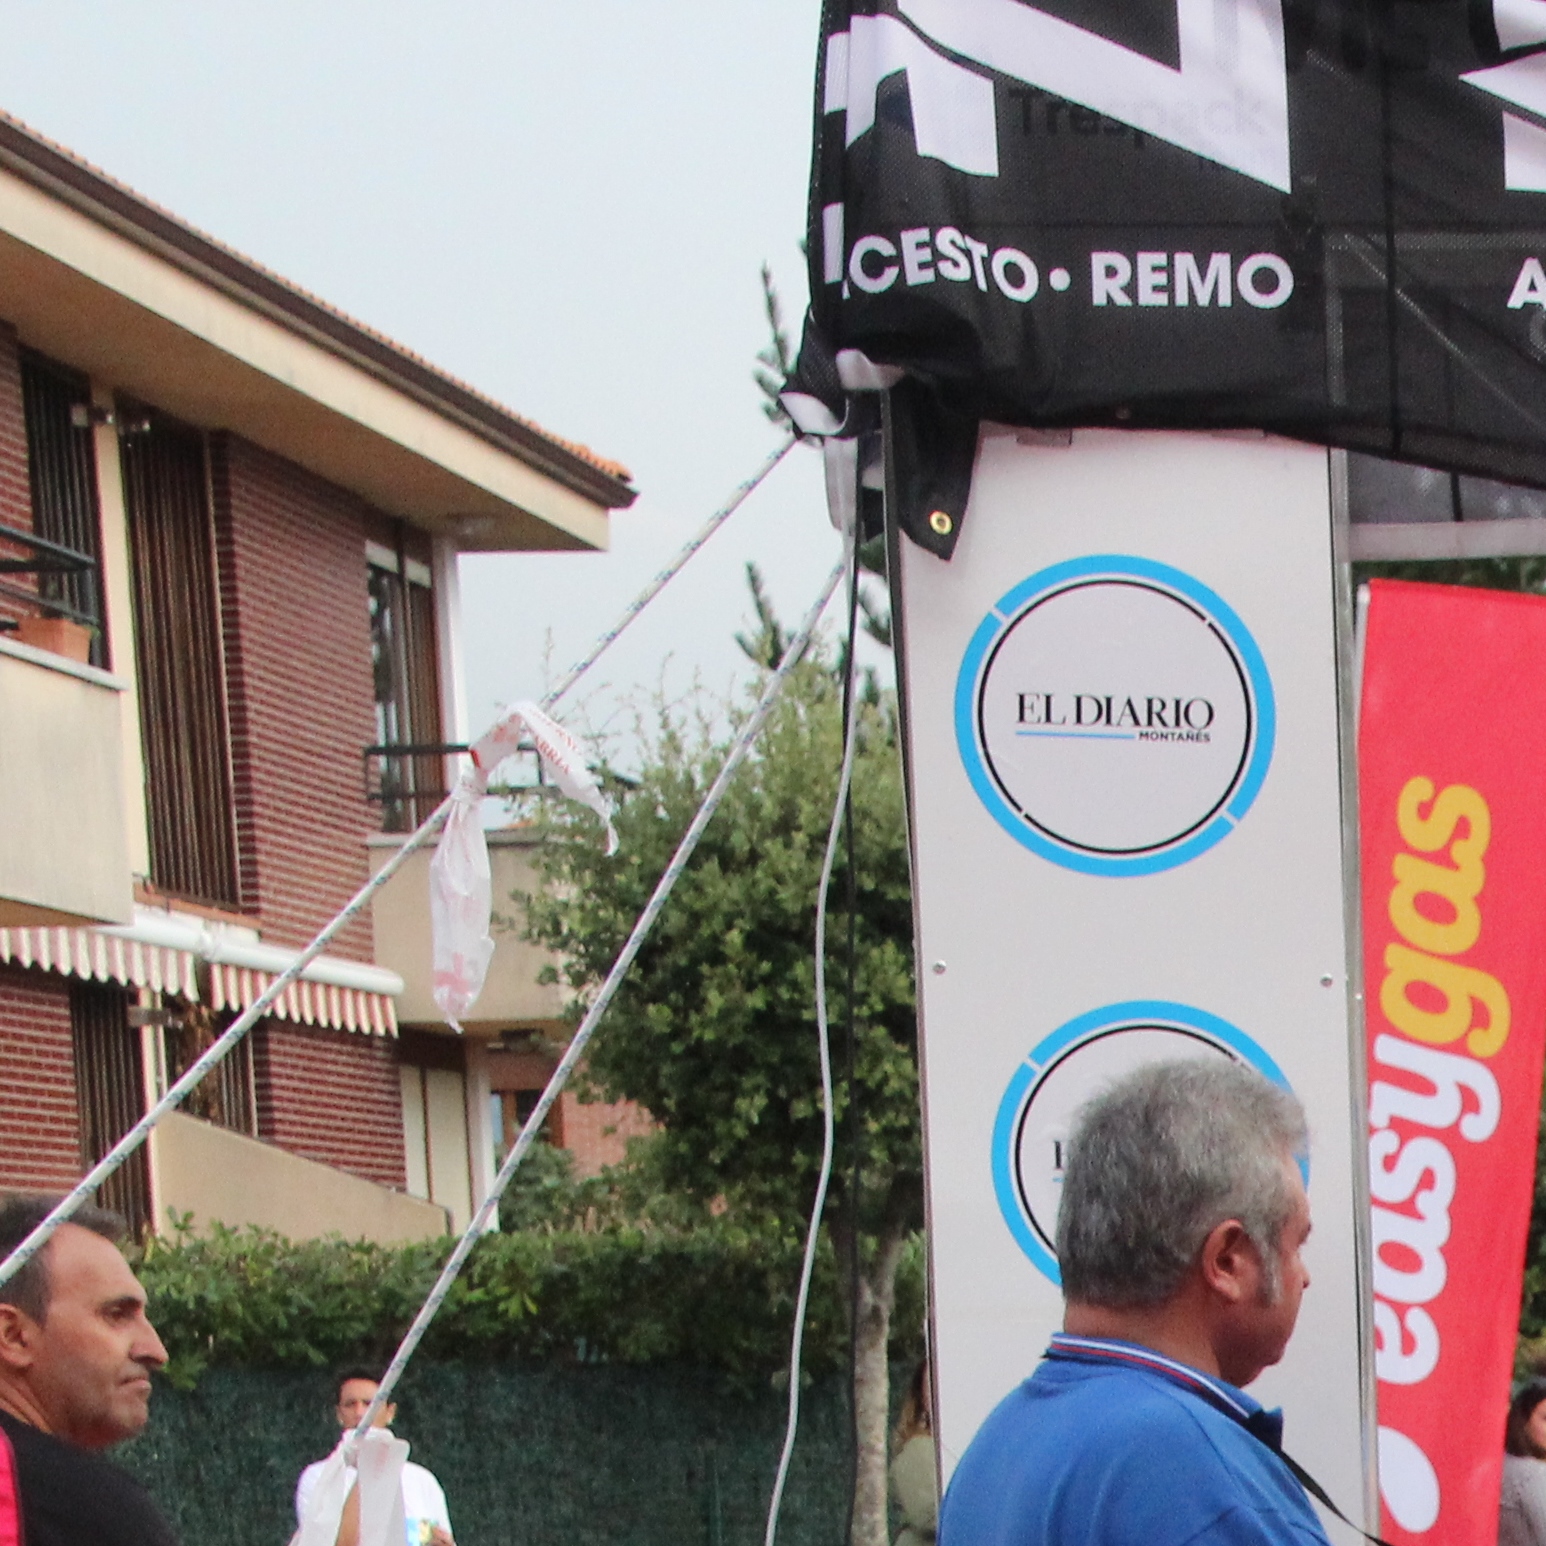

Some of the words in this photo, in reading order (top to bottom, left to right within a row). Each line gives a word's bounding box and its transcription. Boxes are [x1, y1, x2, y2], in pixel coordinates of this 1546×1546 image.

[1091, 252, 1294, 309] REMO
[1016, 692, 1068, 726] EL
[1073, 693, 1215, 730] DIARIO
[1368, 775, 1511, 1385] easygas
